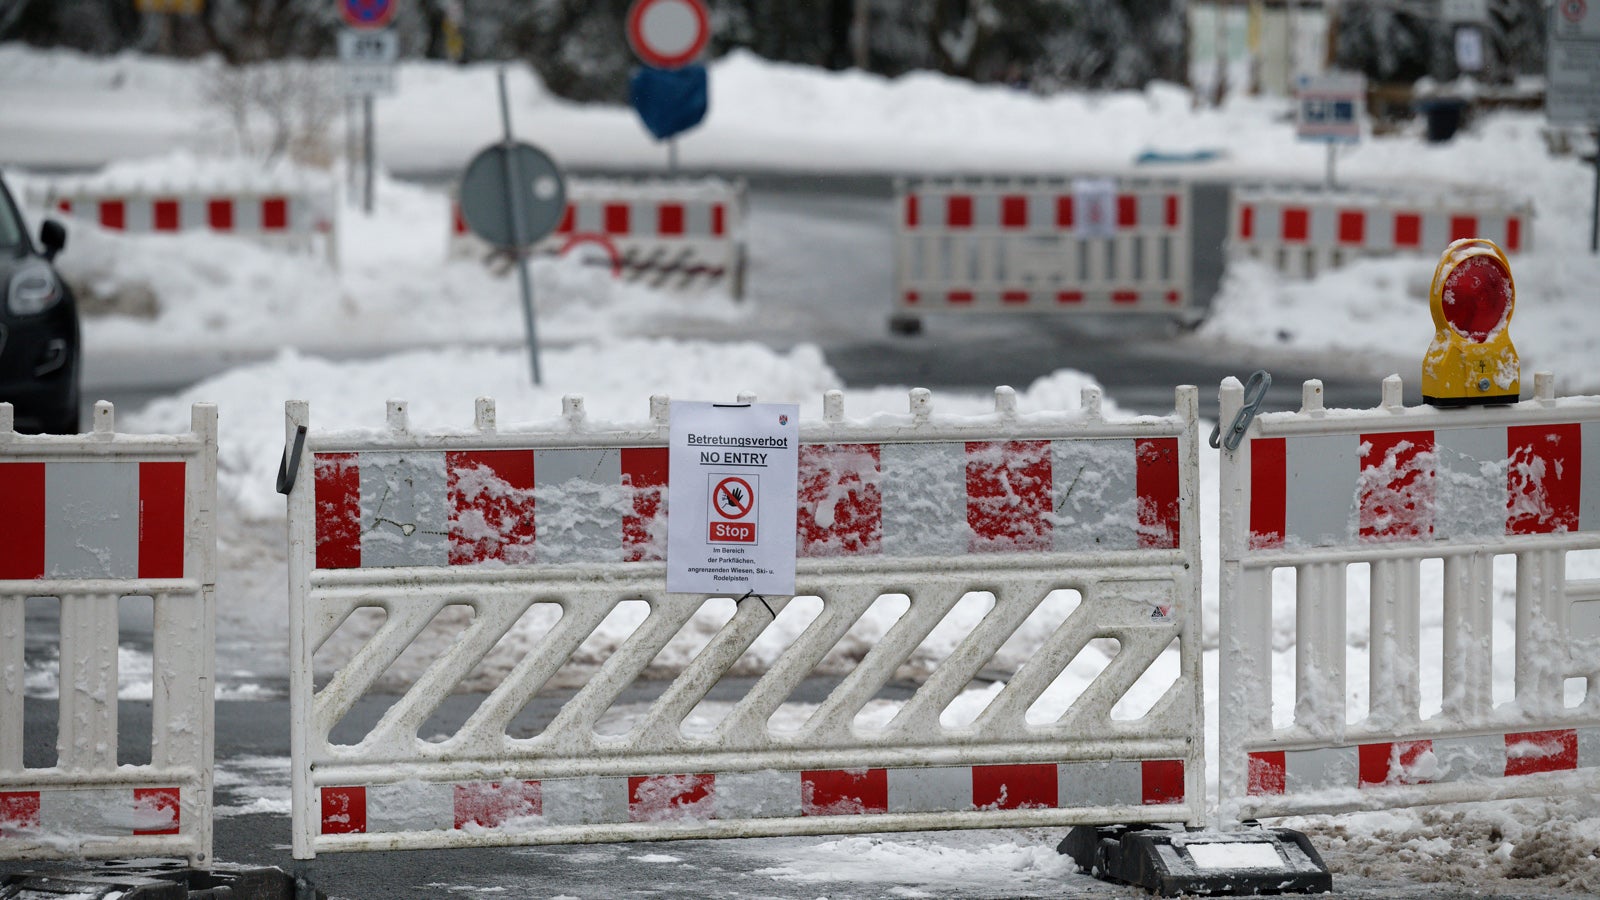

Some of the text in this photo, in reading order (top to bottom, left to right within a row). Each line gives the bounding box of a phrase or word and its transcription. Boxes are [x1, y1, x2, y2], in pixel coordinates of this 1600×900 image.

[687, 433, 788, 447] Betretungsverbot
[700, 452, 768, 464] NO ENTRY
[716, 524, 749, 540] Stop
